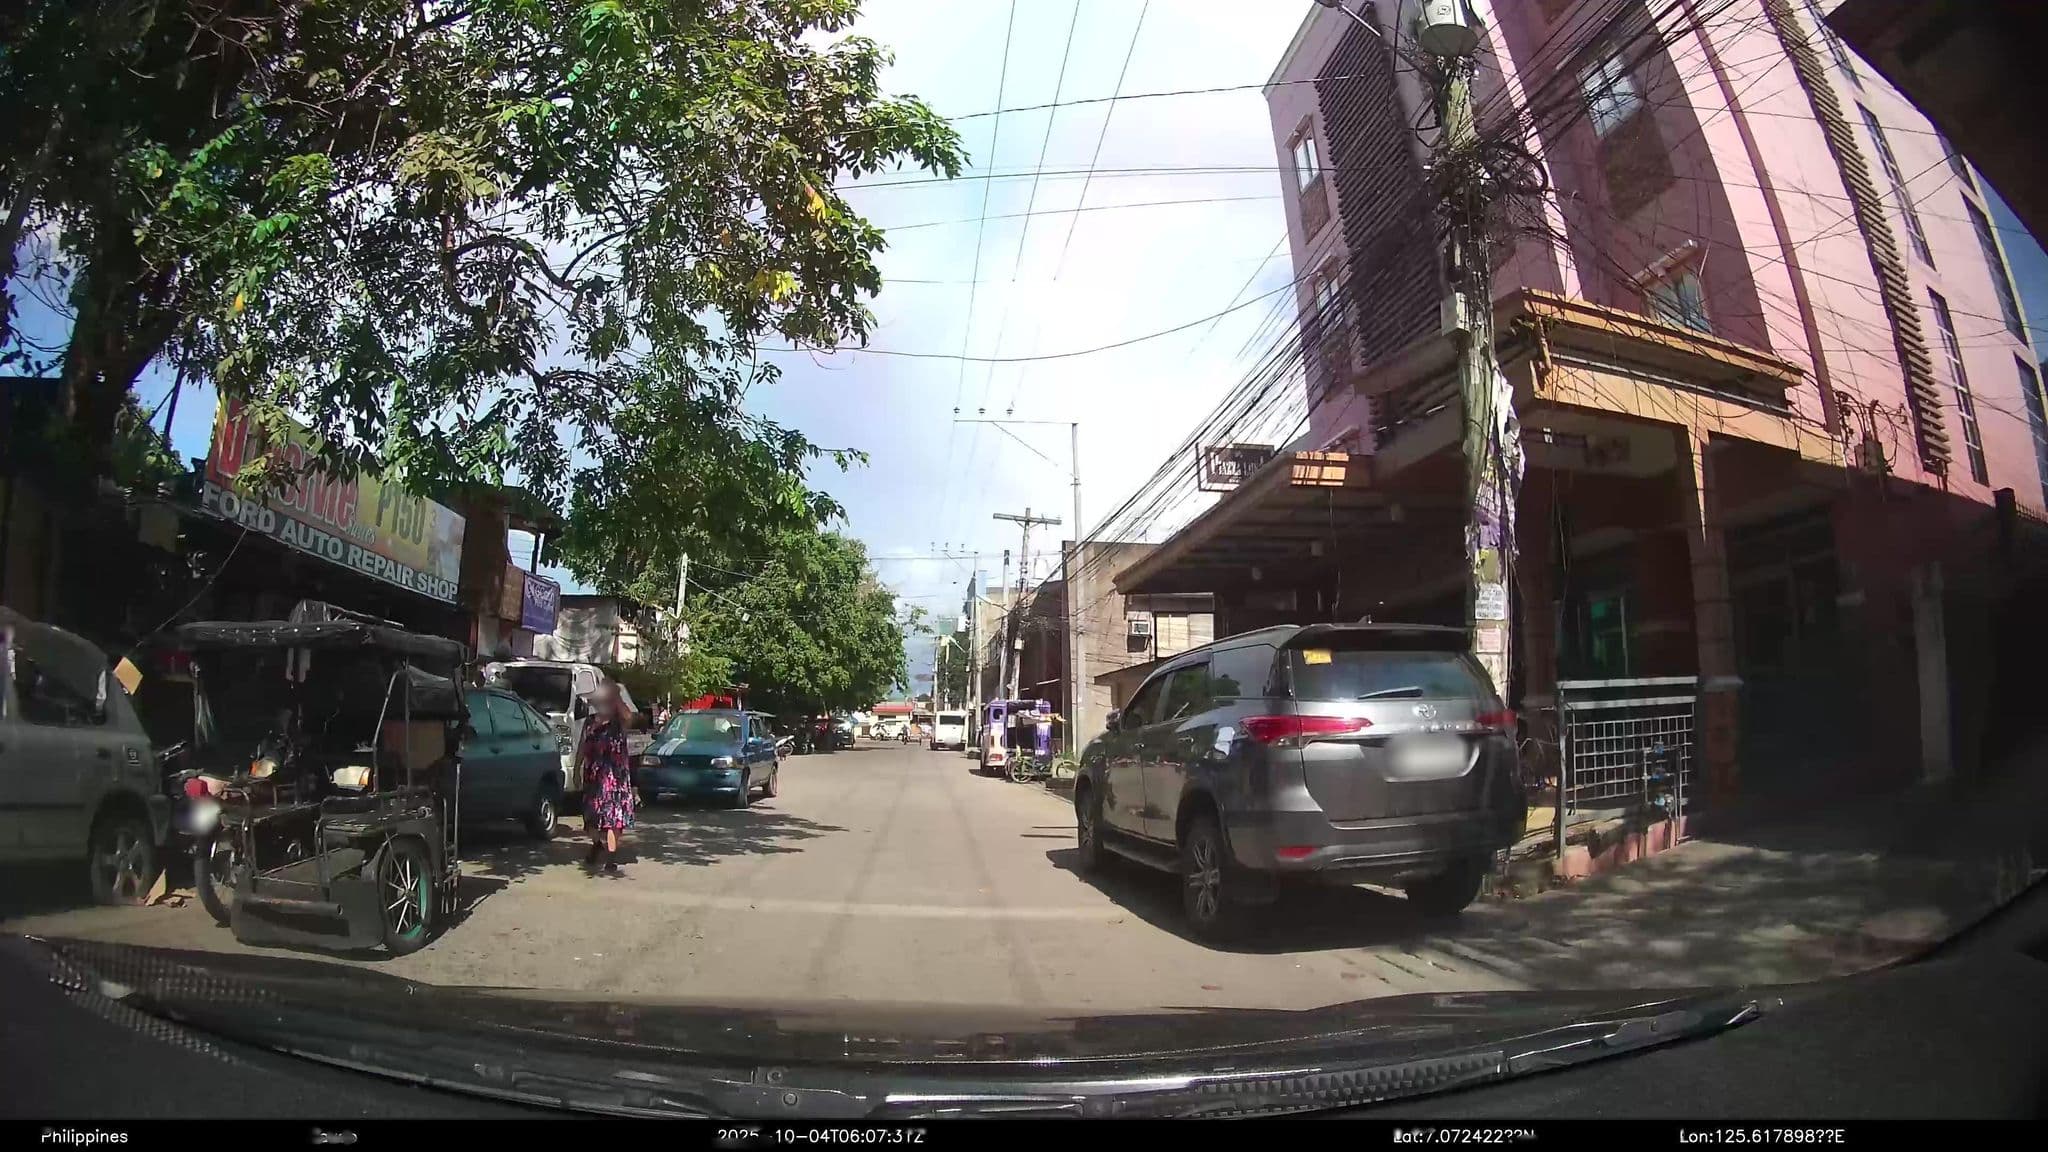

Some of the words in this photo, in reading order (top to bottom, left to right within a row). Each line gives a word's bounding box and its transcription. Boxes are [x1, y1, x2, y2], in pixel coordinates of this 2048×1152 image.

[202, 481, 276, 534] FORD
[279, 518, 344, 561] AUTO
[347, 543, 414, 588] REPAIR
[416, 571, 459, 601] SHOP
